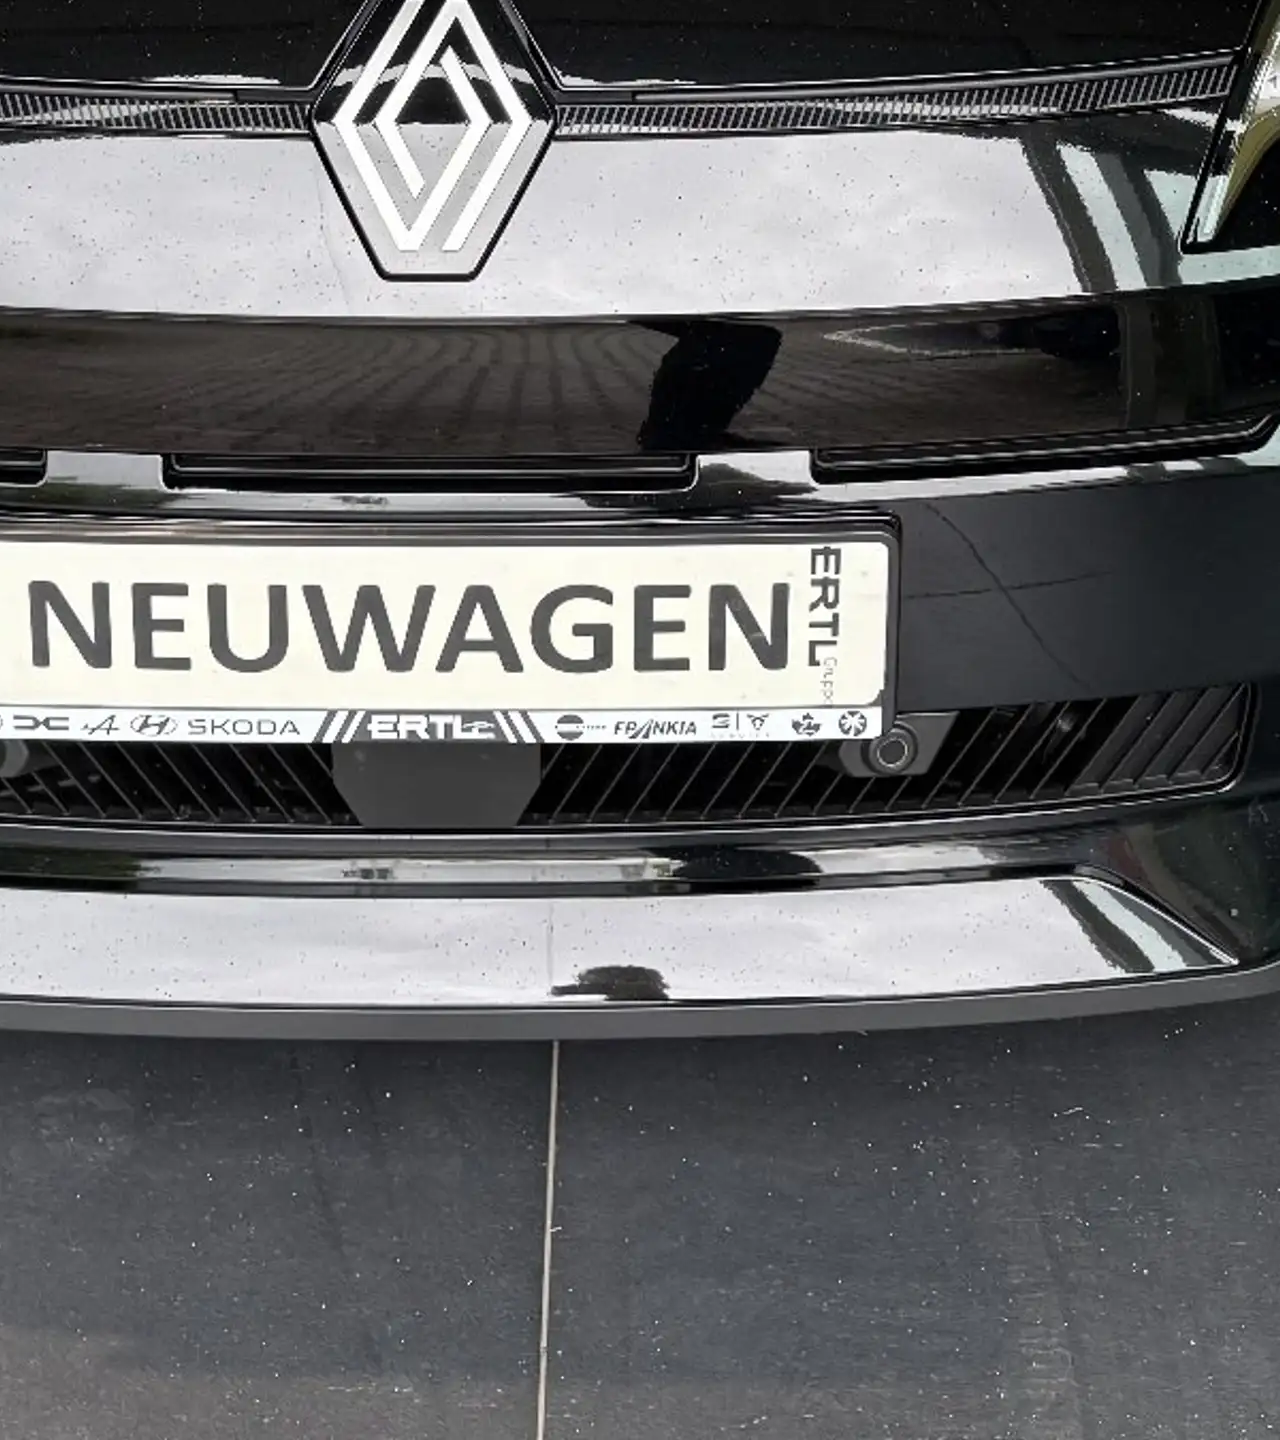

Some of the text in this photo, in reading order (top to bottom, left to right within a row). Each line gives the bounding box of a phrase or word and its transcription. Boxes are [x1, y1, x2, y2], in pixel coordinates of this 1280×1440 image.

[28, 580, 791, 673] NEUWAGEN
[808, 546, 842, 667] ERTL
[367, 714, 495, 739] ERTL
[613, 719, 697, 739] FRANKIA
